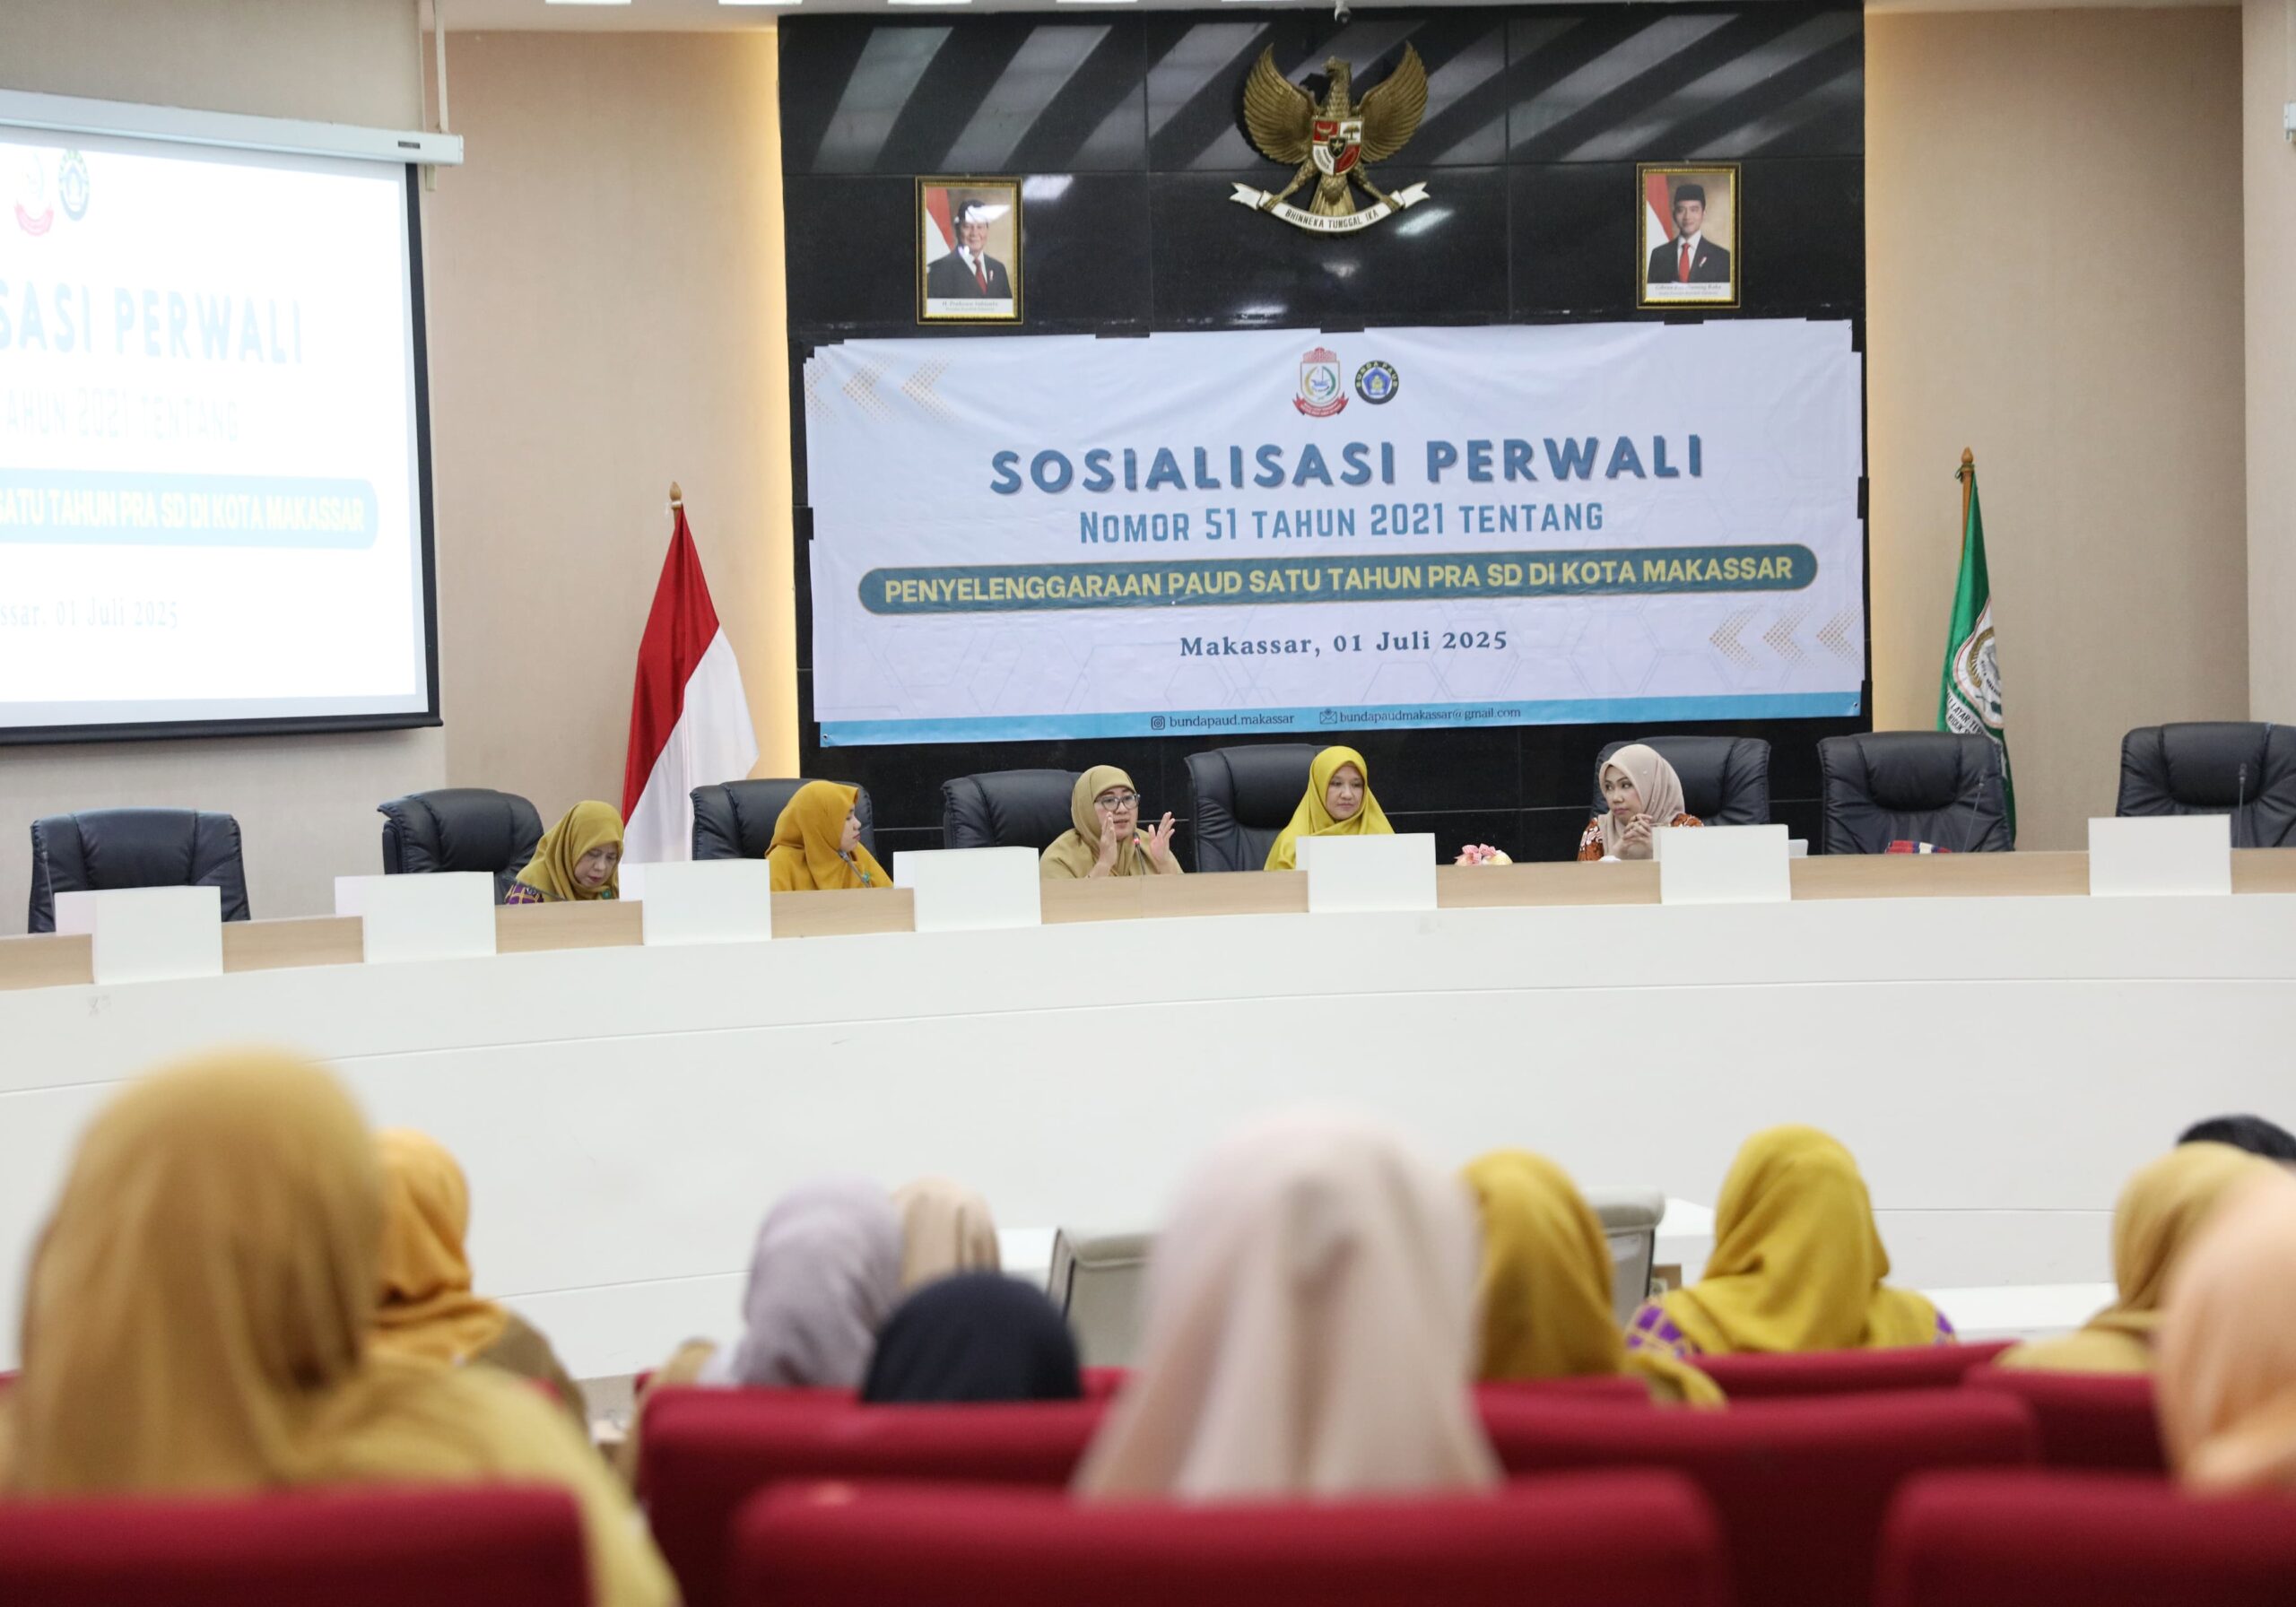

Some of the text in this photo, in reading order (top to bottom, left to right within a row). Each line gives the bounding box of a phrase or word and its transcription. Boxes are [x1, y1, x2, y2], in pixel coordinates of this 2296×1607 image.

[1328, 215, 1361, 229] TUNGGAL
[1365, 209, 1378, 221] IKA
[114, 287, 303, 364] PERWALI
[77, 386, 129, 439] 2021
[140, 395, 239, 444] TENTANG
[990, 435, 1701, 495] SOSIALISASI PERWALI
[48, 489, 117, 527] TAHUN
[120, 491, 157, 529] PRA
[161, 492, 187, 529] SD
[190, 494, 209, 529] DI
[212, 495, 266, 531] KOTA
[266, 496, 365, 533] MAKASSAR
[1206, 508, 1236, 540] 51
[1252, 508, 1354, 538] TAHUN
[1371, 503, 1443, 535] 2021
[1459, 503, 1602, 533] TENTANG
[885, 557, 1792, 603] PENYELENGGARAAN PAUD SATU TAHUN PRA SD DI KOTA MAKASSAR
[56, 600, 75, 626] 01
[86, 595, 125, 627] Juli
[134, 600, 178, 630] 2025
[1181, 631, 1506, 656] Makassar, 01 Juli 2025
[1169, 708, 1521, 728] bundapaud.makassar bundapaudmakassar@gmail.com
